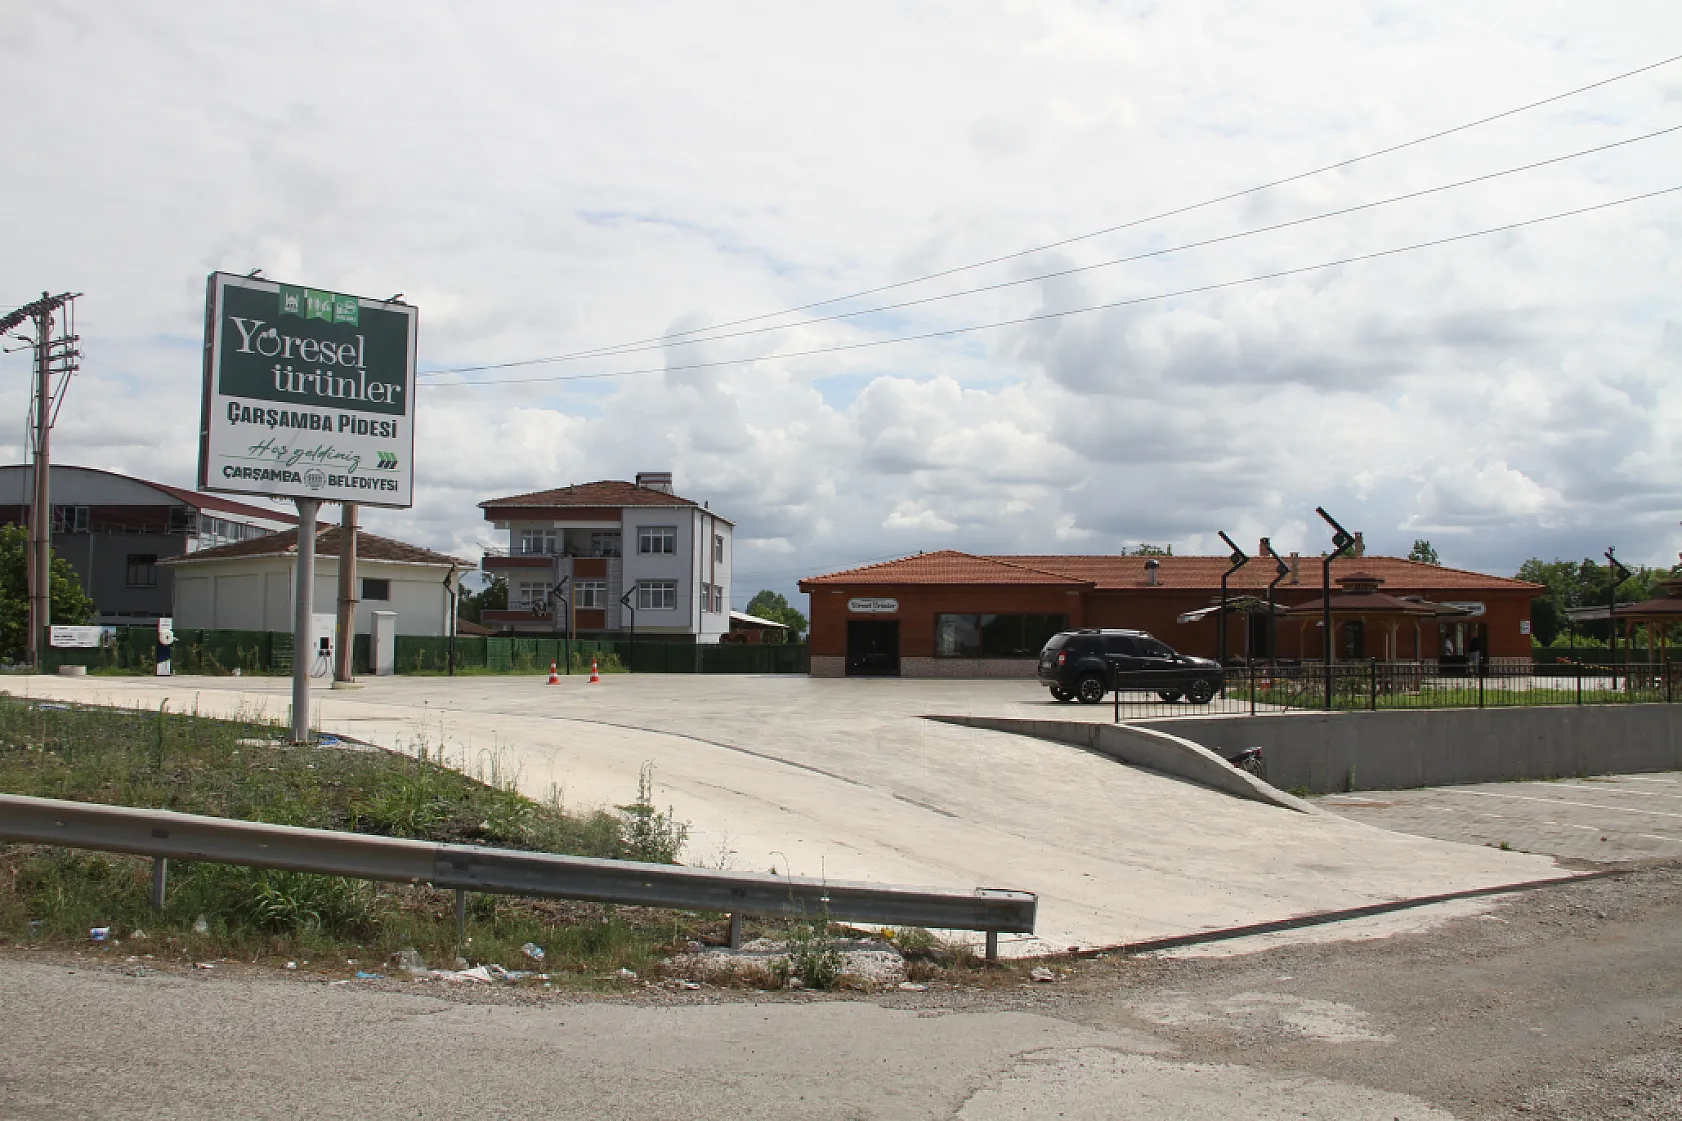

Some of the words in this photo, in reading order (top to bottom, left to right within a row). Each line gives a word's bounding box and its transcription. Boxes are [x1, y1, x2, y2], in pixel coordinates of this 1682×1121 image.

[230, 317, 366, 368] Yöresel
[272, 364, 401, 404] ürünler
[228, 402, 333, 431] ÇARŞAMBA
[339, 415, 397, 438] PİDESİ
[223, 466, 302, 482] ÇARŞAMBA
[329, 476, 398, 491] BELEDİYESİ
